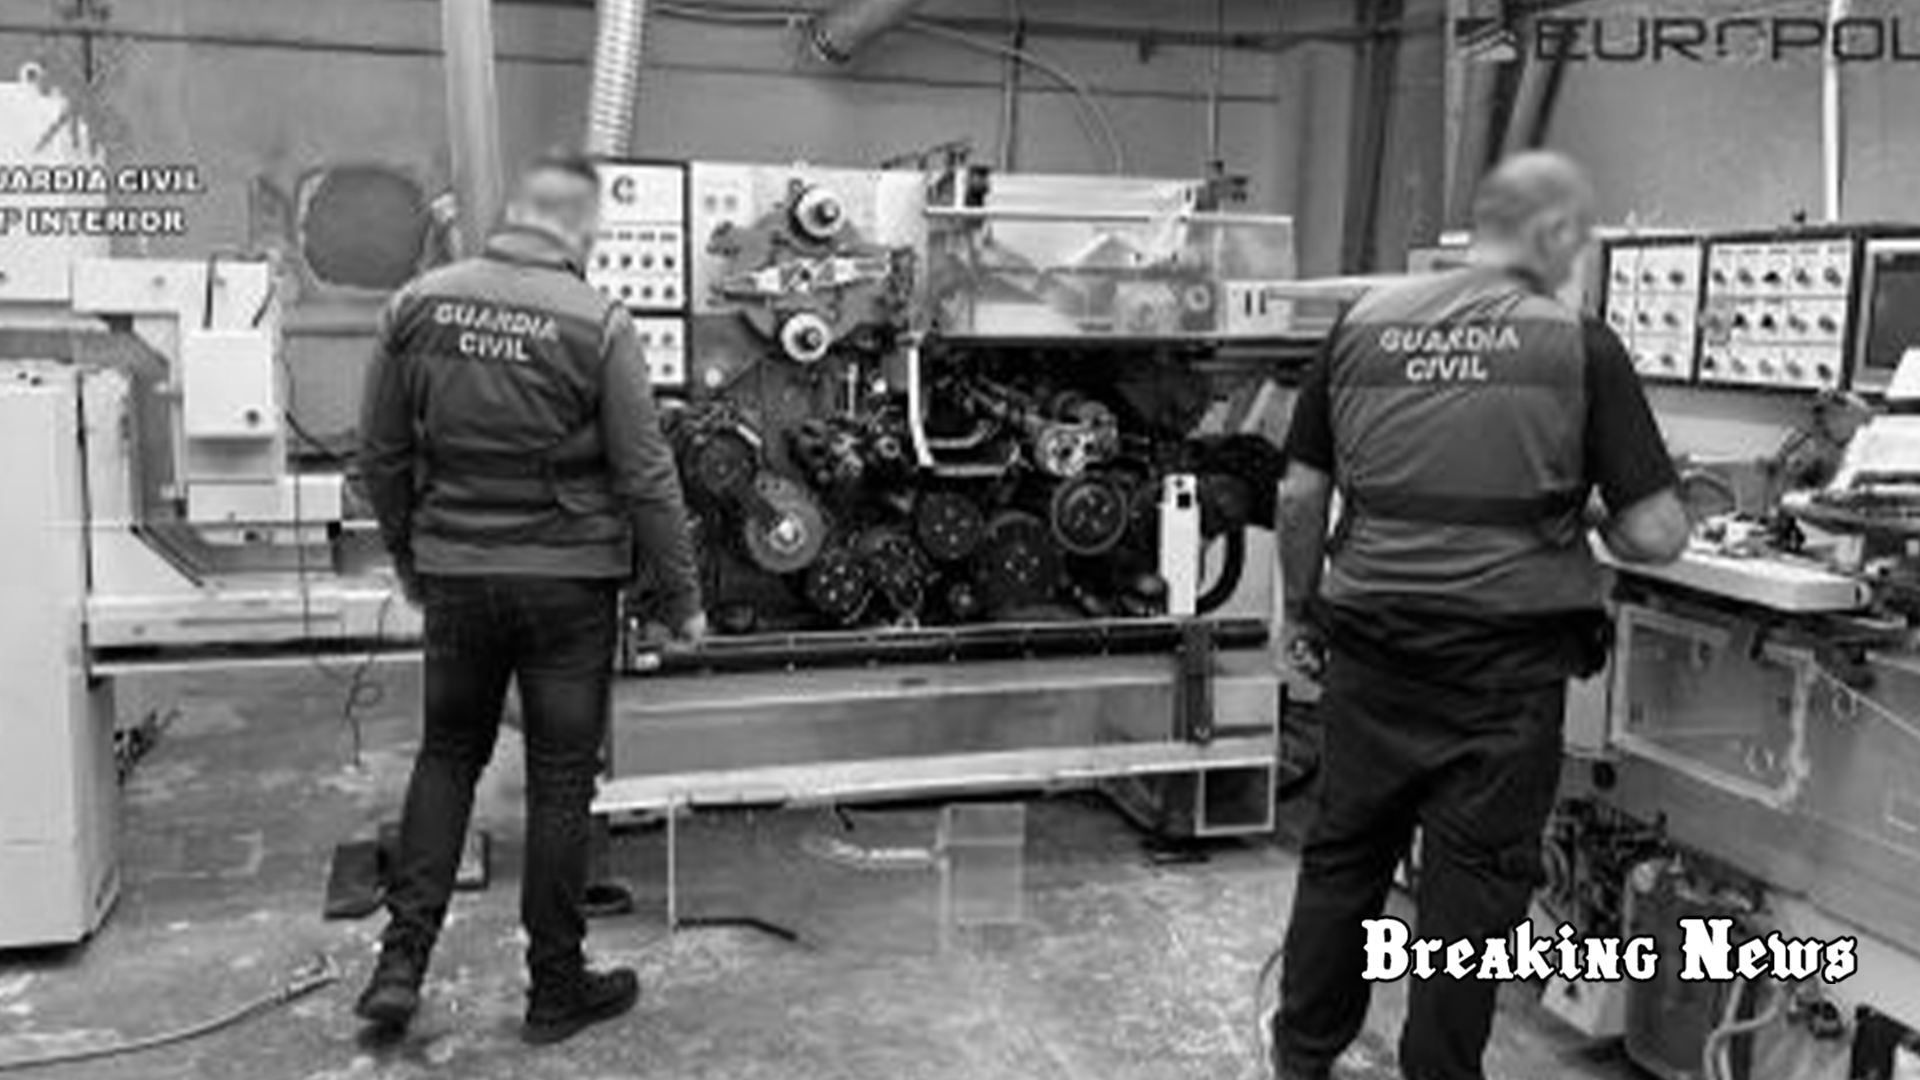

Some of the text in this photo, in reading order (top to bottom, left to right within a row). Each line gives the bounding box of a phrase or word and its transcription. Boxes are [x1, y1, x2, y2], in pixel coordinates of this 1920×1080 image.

[434, 302, 560, 342] GUARDIA
[459, 332, 531, 362] CIVIL
[1379, 325, 1521, 352] GUARDIA
[1406, 355, 1488, 381] CIVIL
